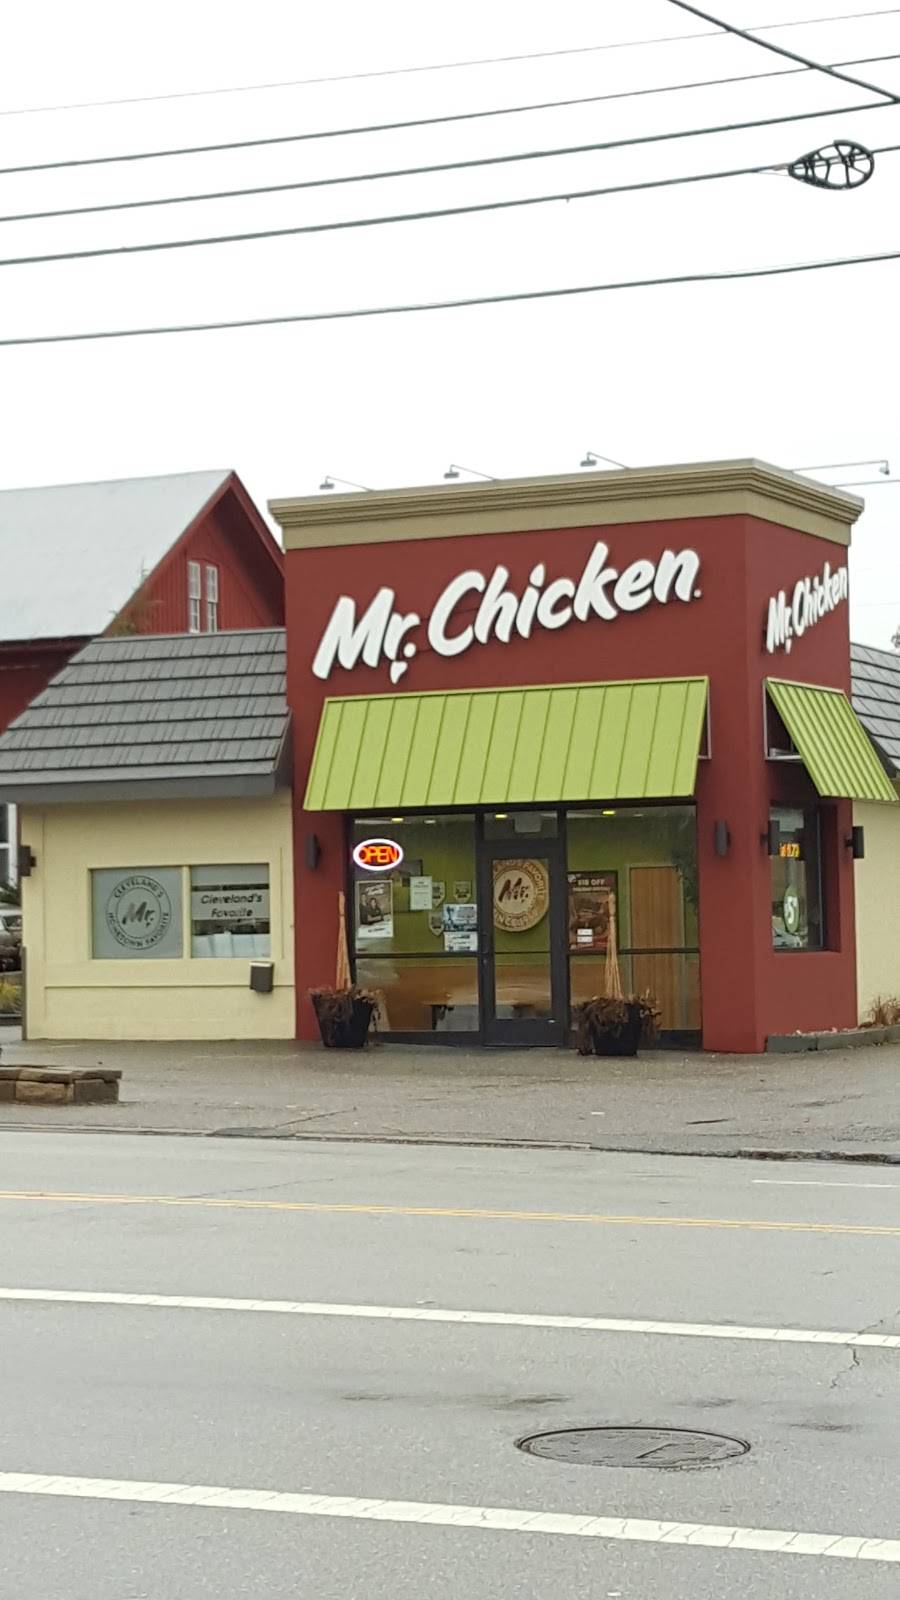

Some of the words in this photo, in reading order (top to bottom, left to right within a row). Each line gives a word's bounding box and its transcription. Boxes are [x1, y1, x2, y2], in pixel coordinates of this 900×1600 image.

[312, 586, 421, 684] Mr.
[428, 541, 699, 657] Chicken
[766, 590, 792, 654] Mr.
[792, 561, 847, 637] Chicken
[359, 845, 398, 863] OPEN
[498, 877, 529, 903] Mr.
[591, 878, 606, 886] OFF
[201, 893, 263, 904] Cleveland's
[122, 901, 155, 928] Mr.
[211, 908, 253, 918] Favorite
